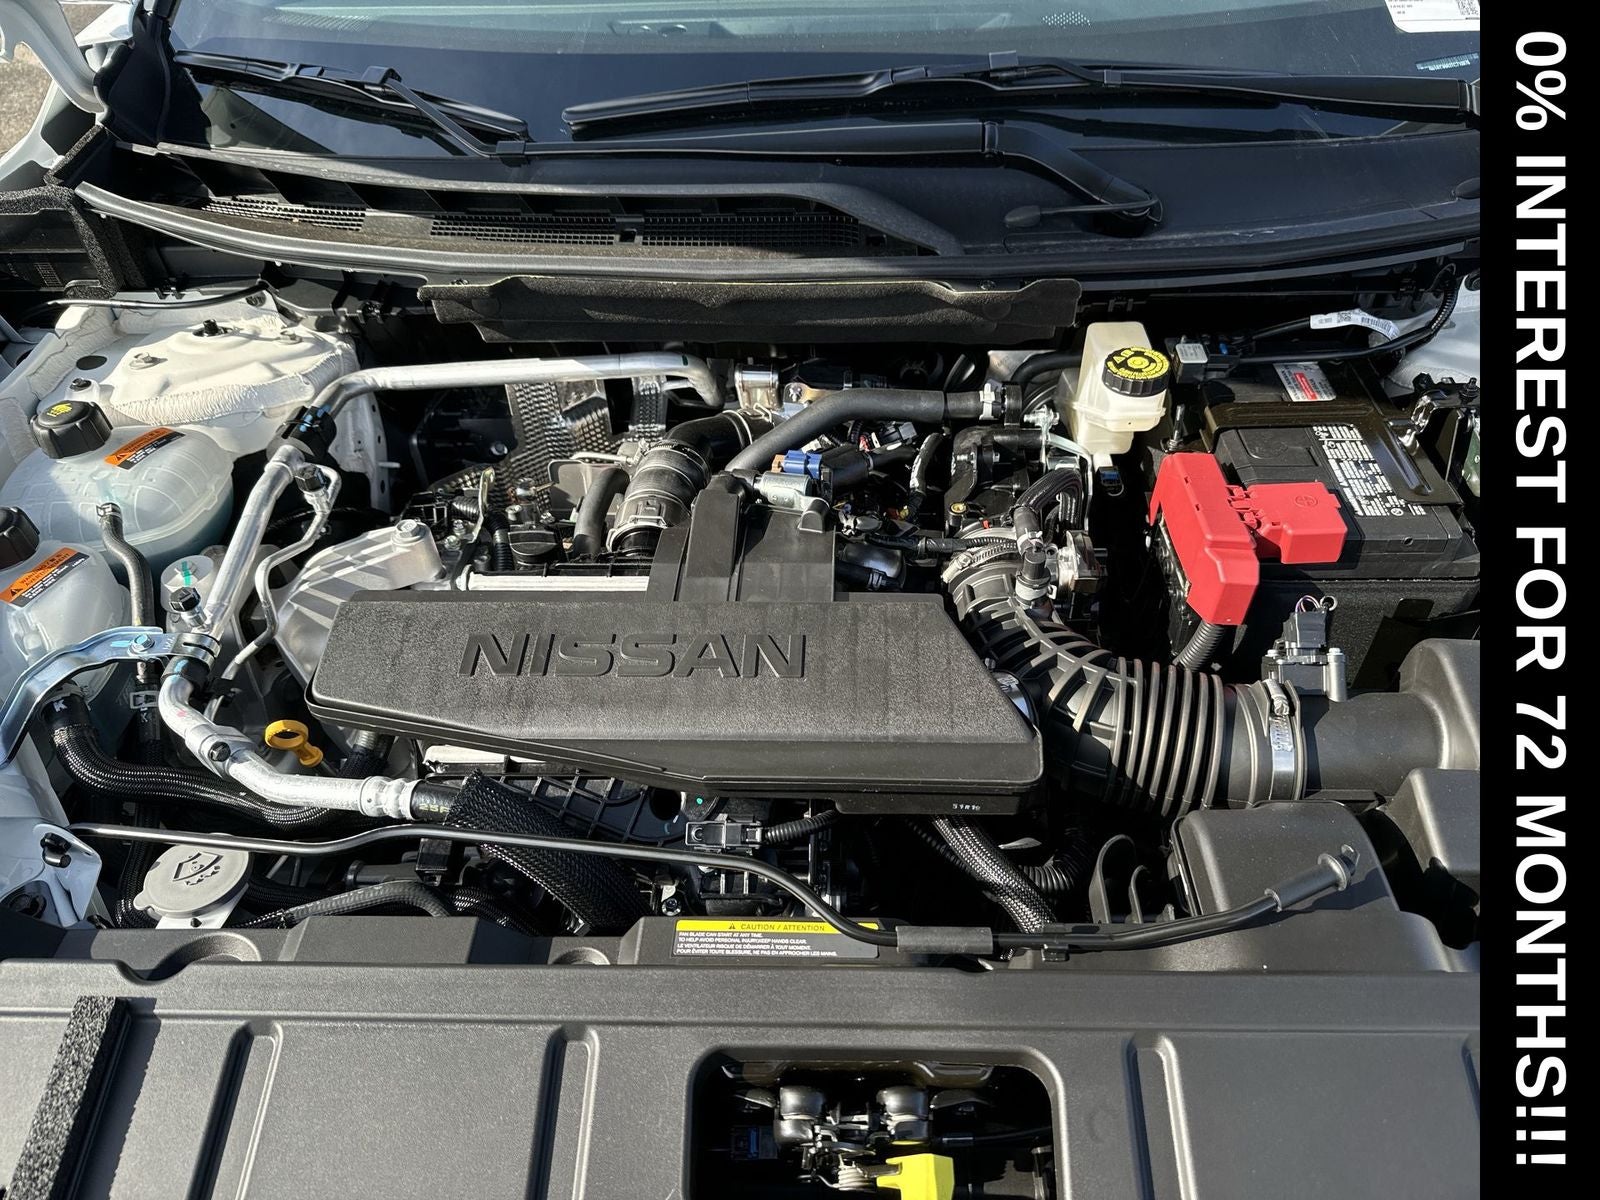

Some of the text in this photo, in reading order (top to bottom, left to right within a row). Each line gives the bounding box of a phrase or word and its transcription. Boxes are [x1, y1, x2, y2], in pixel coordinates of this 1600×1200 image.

[458, 633, 806, 678] NISSAN
[740, 923, 775, 931] CAUTION
[783, 924, 825, 932] ATTENTION
